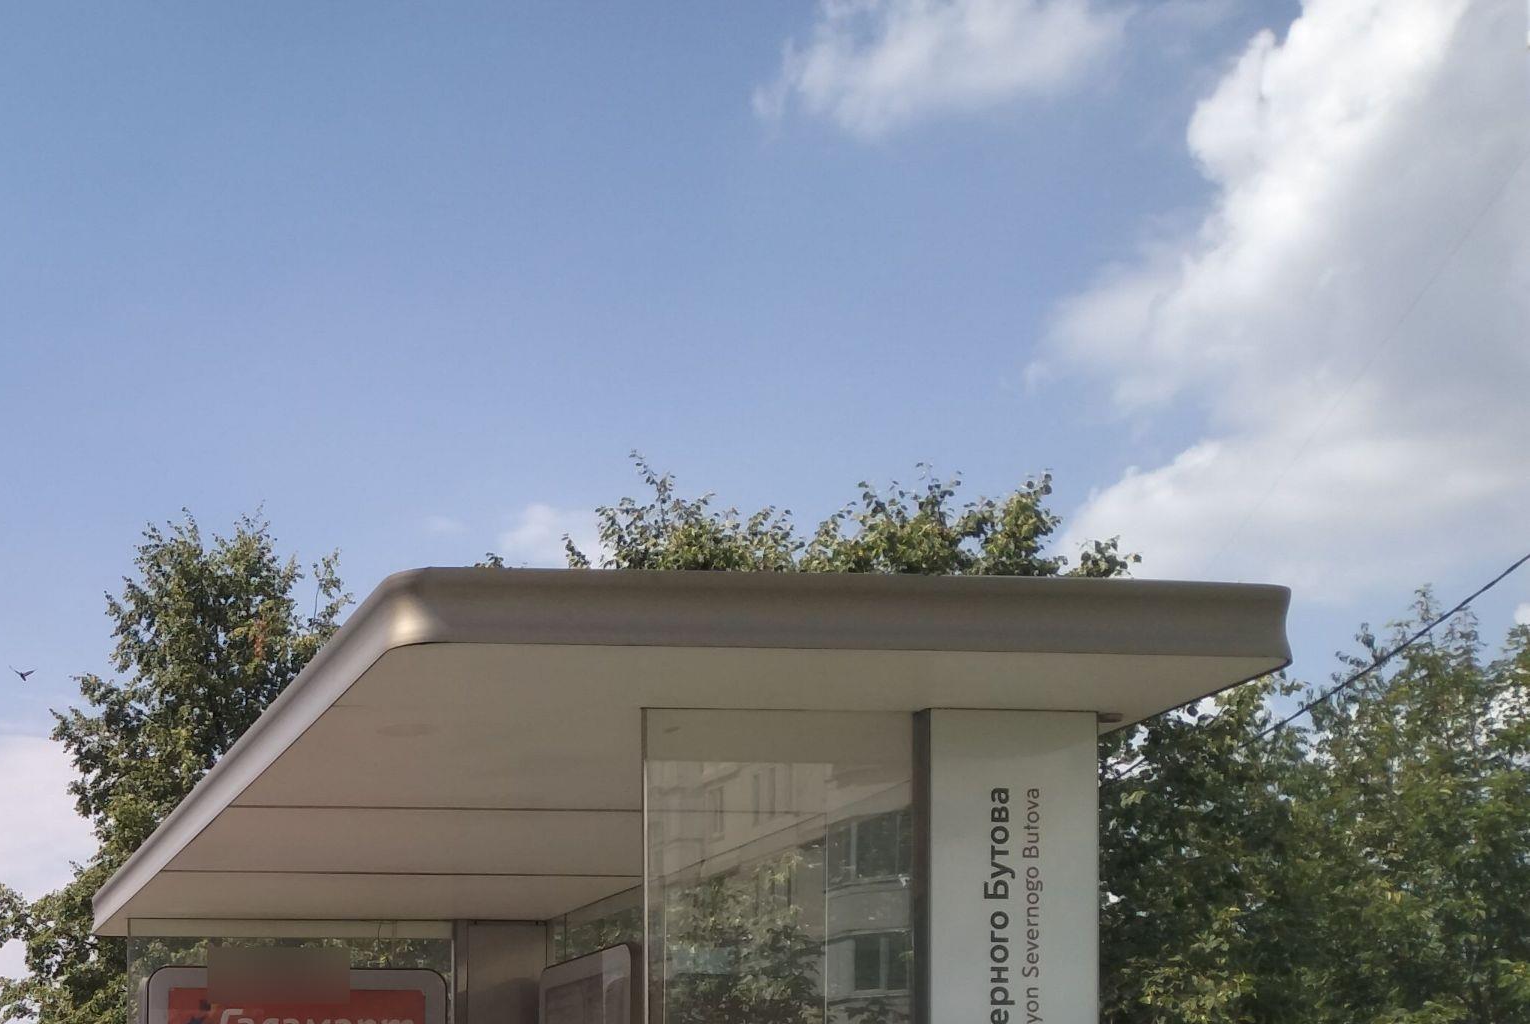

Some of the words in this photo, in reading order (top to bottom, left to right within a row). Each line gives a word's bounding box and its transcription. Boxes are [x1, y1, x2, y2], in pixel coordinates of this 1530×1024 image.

[984, 787, 1015, 900] Бутова
[1022, 788, 1040, 859] Butova
[1022, 866, 1043, 978] Severnogo
